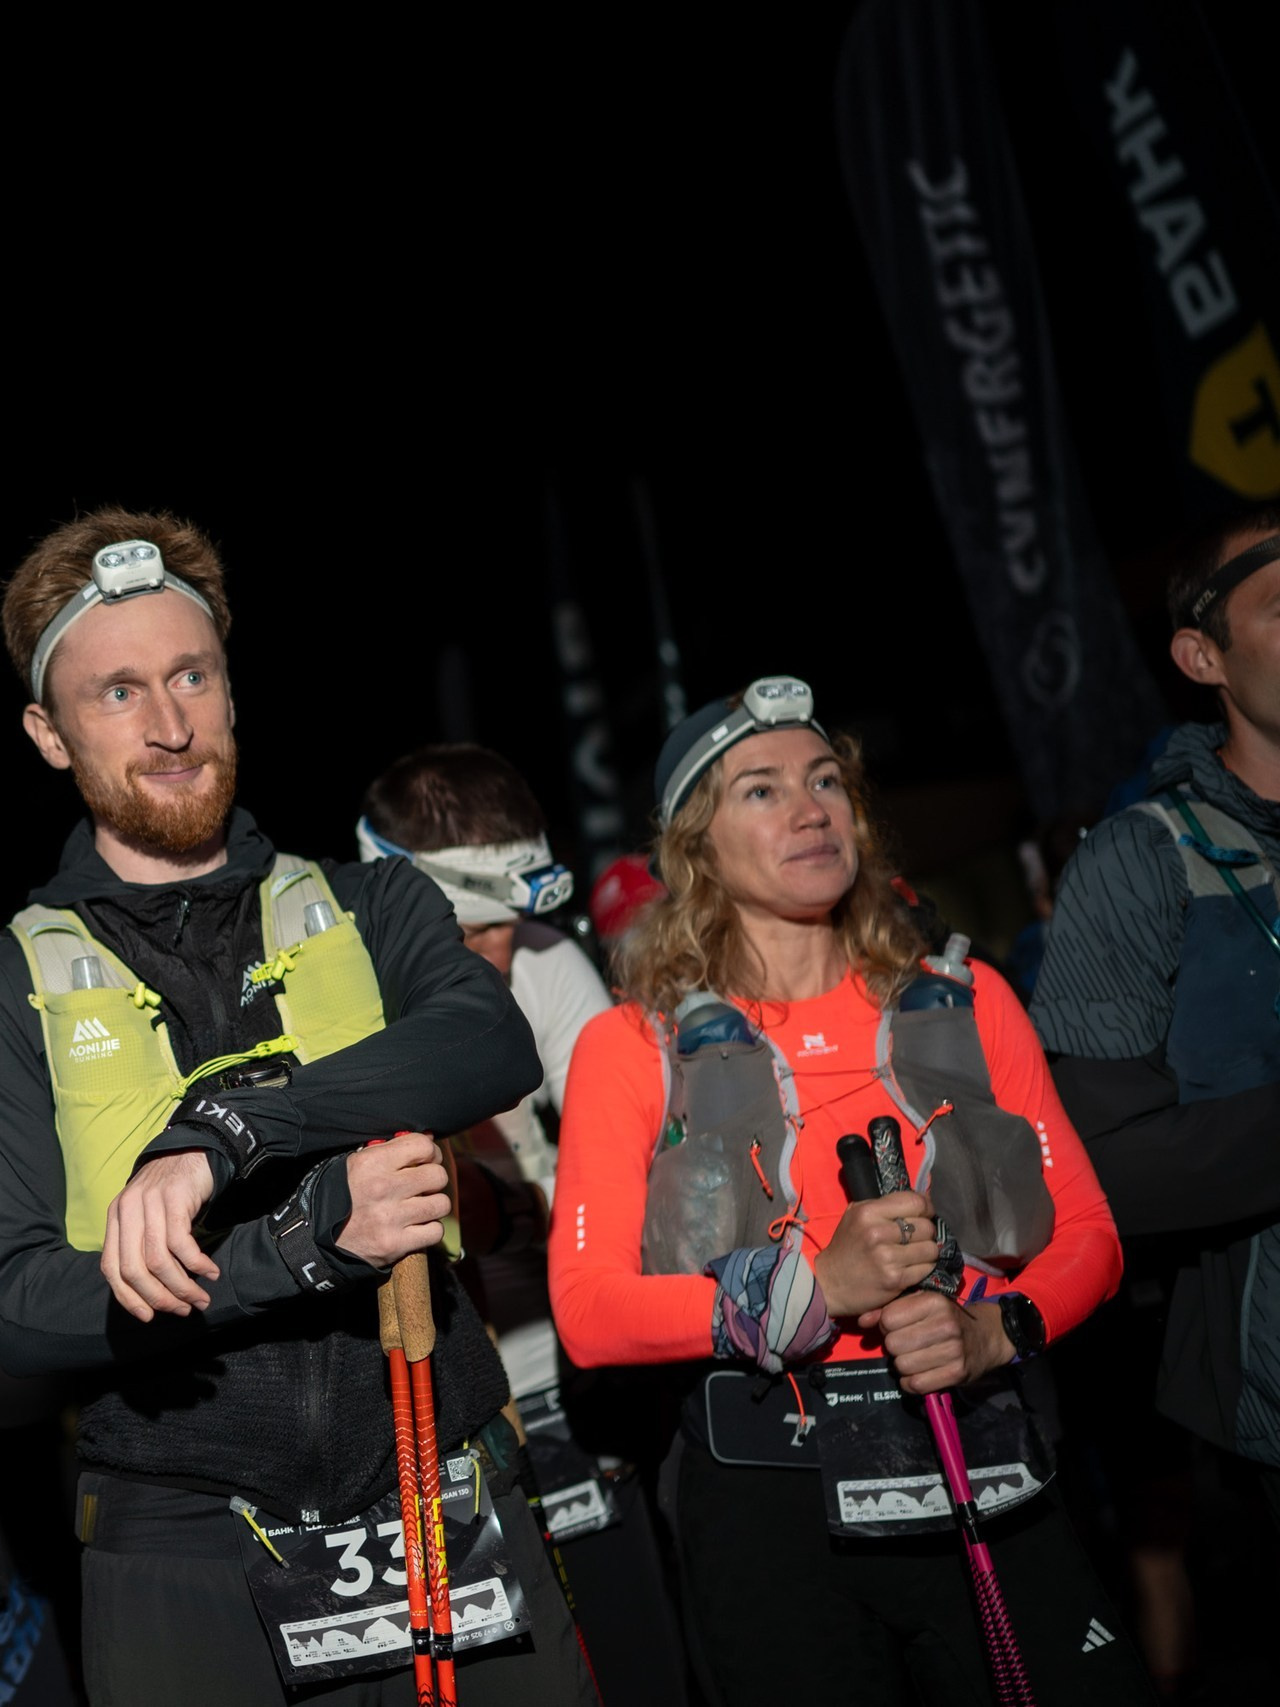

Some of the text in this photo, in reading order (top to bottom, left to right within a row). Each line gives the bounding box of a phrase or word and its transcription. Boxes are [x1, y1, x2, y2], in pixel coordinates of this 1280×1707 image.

[68, 1038, 121, 1058] AONIJIE
[195, 1099, 258, 1155] LEKI
[267, 1526, 295, 1538] БАНК
[324, 1519, 409, 1597] 33
